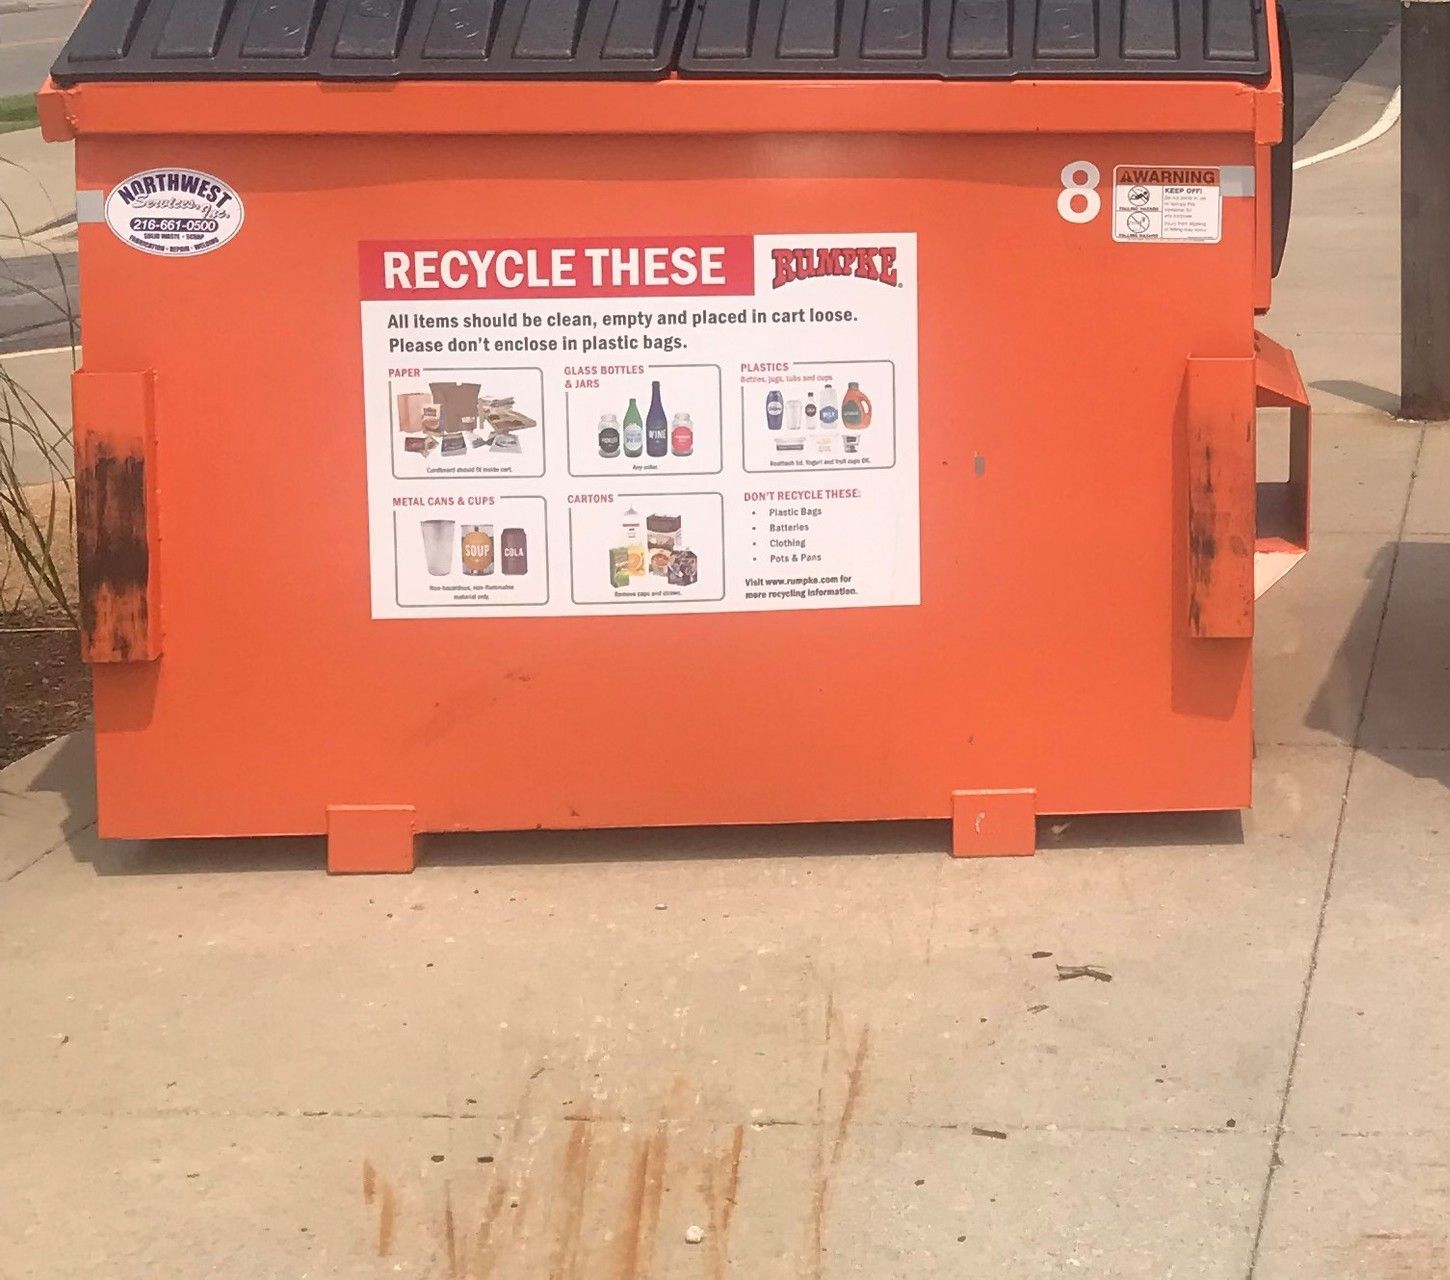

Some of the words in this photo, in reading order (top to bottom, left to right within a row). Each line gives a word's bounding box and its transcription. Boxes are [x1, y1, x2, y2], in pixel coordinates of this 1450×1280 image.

[1133, 170, 1215, 184] WARNING
[118, 173, 232, 209] NORTHWEST
[1057, 160, 1101, 223] 8
[133, 219, 216, 231] 216-661-0500
[384, 248, 576, 289] RECYCLE
[584, 247, 726, 287] THESE
[771, 247, 897, 289] RUMPKE
[388, 314, 408, 329] All
[414, 313, 459, 328] items
[463, 313, 517, 328] should
[523, 312, 542, 327] be
[547, 312, 597, 329] clean,
[602, 311, 652, 329] empty
[657, 310, 687, 325] and
[692, 309, 747, 327] placed
[752, 309, 767, 323] in
[771, 309, 805, 323] cart
[810, 308, 858, 322] loose.
[389, 338, 443, 353] Please
[448, 337, 490, 352] don't
[494, 336, 557, 351] enclose
[562, 336, 578, 351] in
[582, 335, 638, 354] plastic
[643, 335, 688, 352] bags.
[388, 368, 421, 378] PAPER
[564, 366, 598, 375] GLASS
[601, 365, 645, 375] BOTTLES
[741, 363, 789, 372] PLASTICS
[565, 379, 572, 388] &
[575, 379, 600, 388] JARS
[648, 429, 666, 439] WINE
[393, 497, 425, 506] METAL
[428, 497, 454, 506] CANS
[457, 497, 465, 506] &
[468, 496, 495, 506] CUPS
[567, 494, 614, 504] CARTONS
[744, 491, 774, 502] DON'T
[777, 490, 823, 501] RECYCLE
[825, 489, 861, 499] THESE:
[769, 508, 799, 517] Plastic
[800, 507, 822, 517] Bags
[770, 523, 809, 532] Batteries
[770, 539, 806, 548] Clothing
[465, 544, 490, 557] SOUP
[504, 547, 524, 557] COLA
[770, 554, 789, 563] Pots
[791, 554, 798, 562] &
[800, 553, 822, 562] Pans
[745, 577, 764, 587] Visit
[766, 576, 838, 587] www.rumpke.com
[840, 575, 851, 583] for
[745, 591, 766, 599] more
[768, 589, 806, 600] recycling
[807, 587, 858, 597] information.
